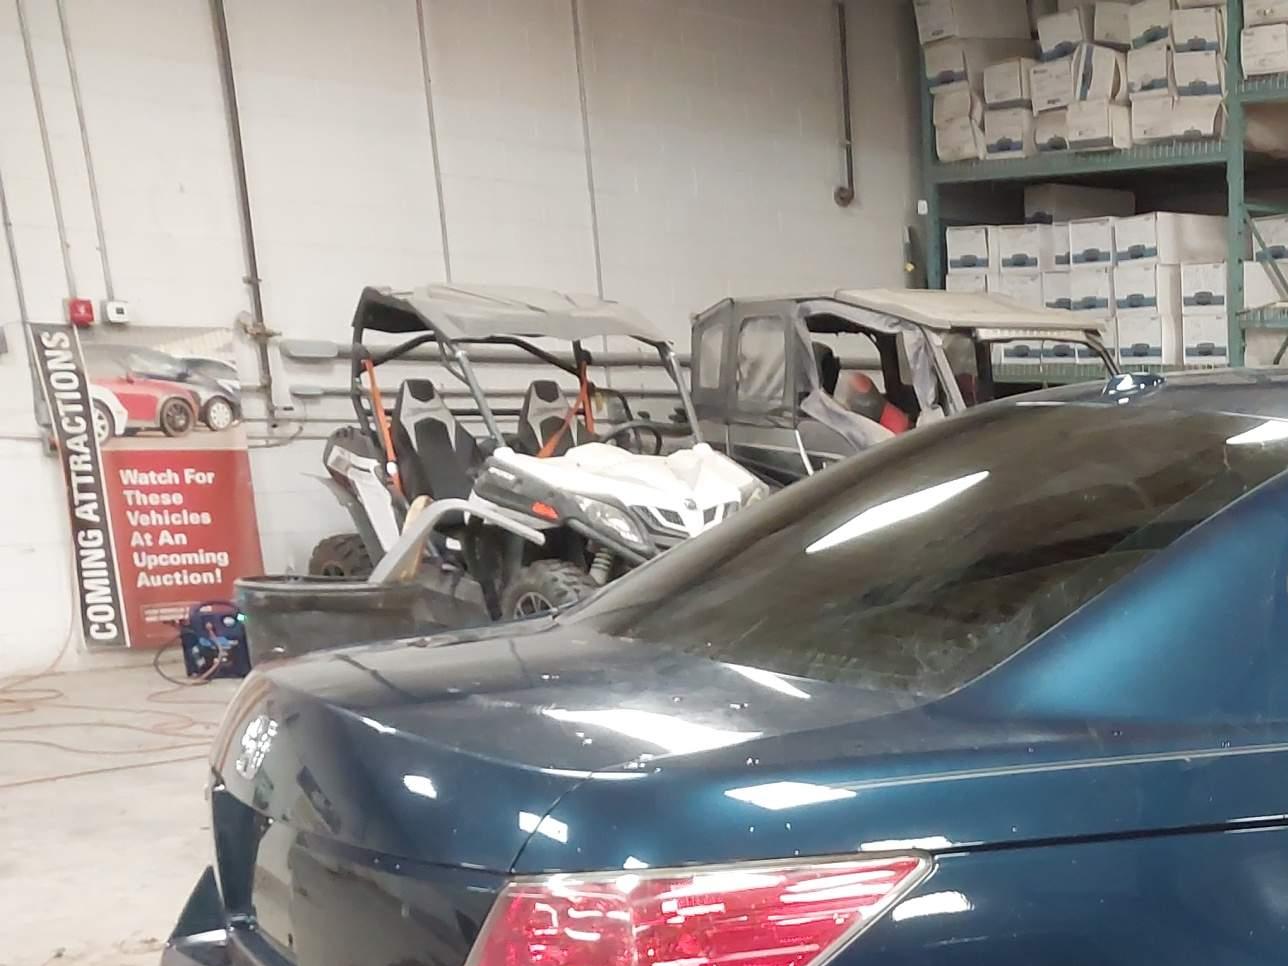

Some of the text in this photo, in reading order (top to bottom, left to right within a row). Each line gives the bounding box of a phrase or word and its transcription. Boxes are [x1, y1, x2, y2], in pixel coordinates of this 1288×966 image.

[41, 331, 118, 640] COMING ATTRACTIONS
[119, 468, 215, 486] Watch For
[122, 489, 184, 506] These
[126, 509, 211, 527] Vehicles
[130, 529, 188, 547] At An
[132, 548, 230, 570] Upcoming
[136, 567, 222, 588] Auction!
